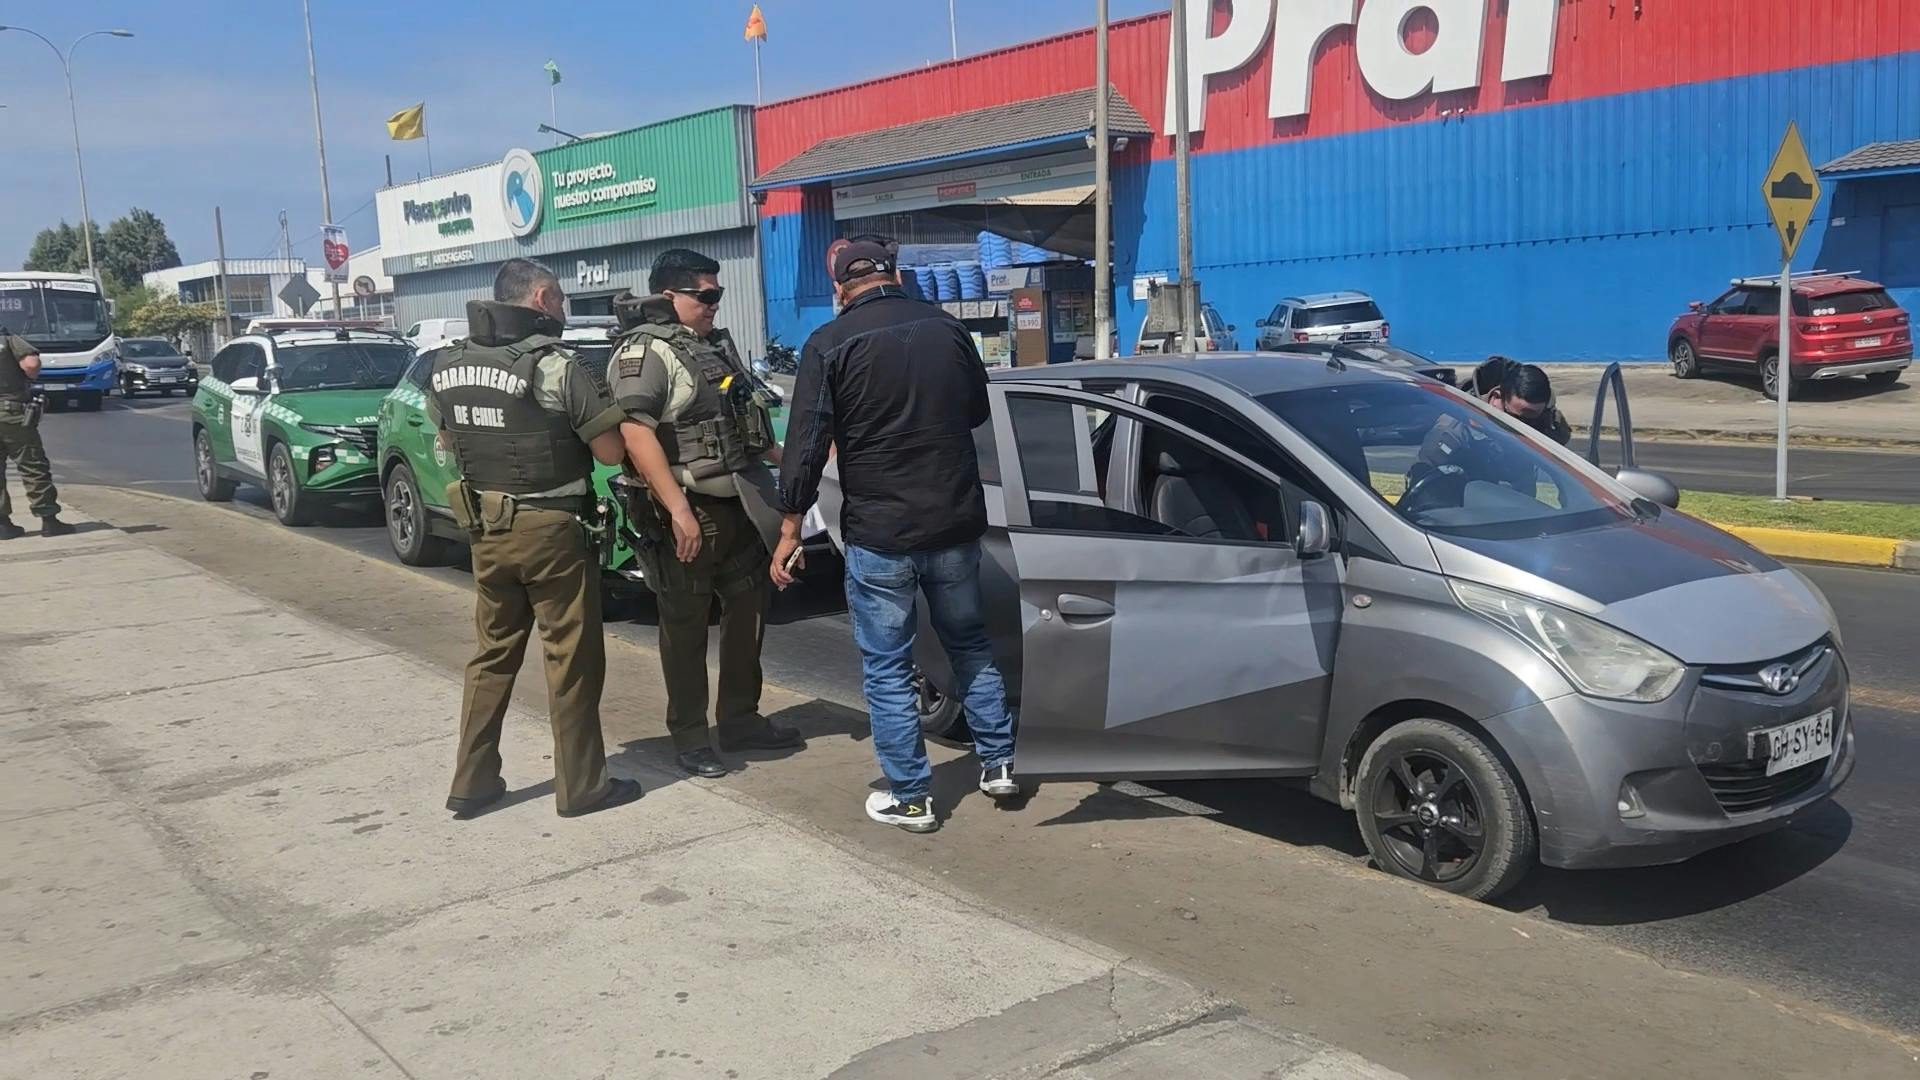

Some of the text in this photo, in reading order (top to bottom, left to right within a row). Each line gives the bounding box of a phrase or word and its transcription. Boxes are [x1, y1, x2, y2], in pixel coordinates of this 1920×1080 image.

[552, 163, 616, 188] Tu proyecto,
[554, 175, 656, 209] nuestro compromiso
[577, 260, 610, 285] Prat
[432, 366, 527, 398] CARABINEROS
[454, 405, 505, 428] DE CHILE
